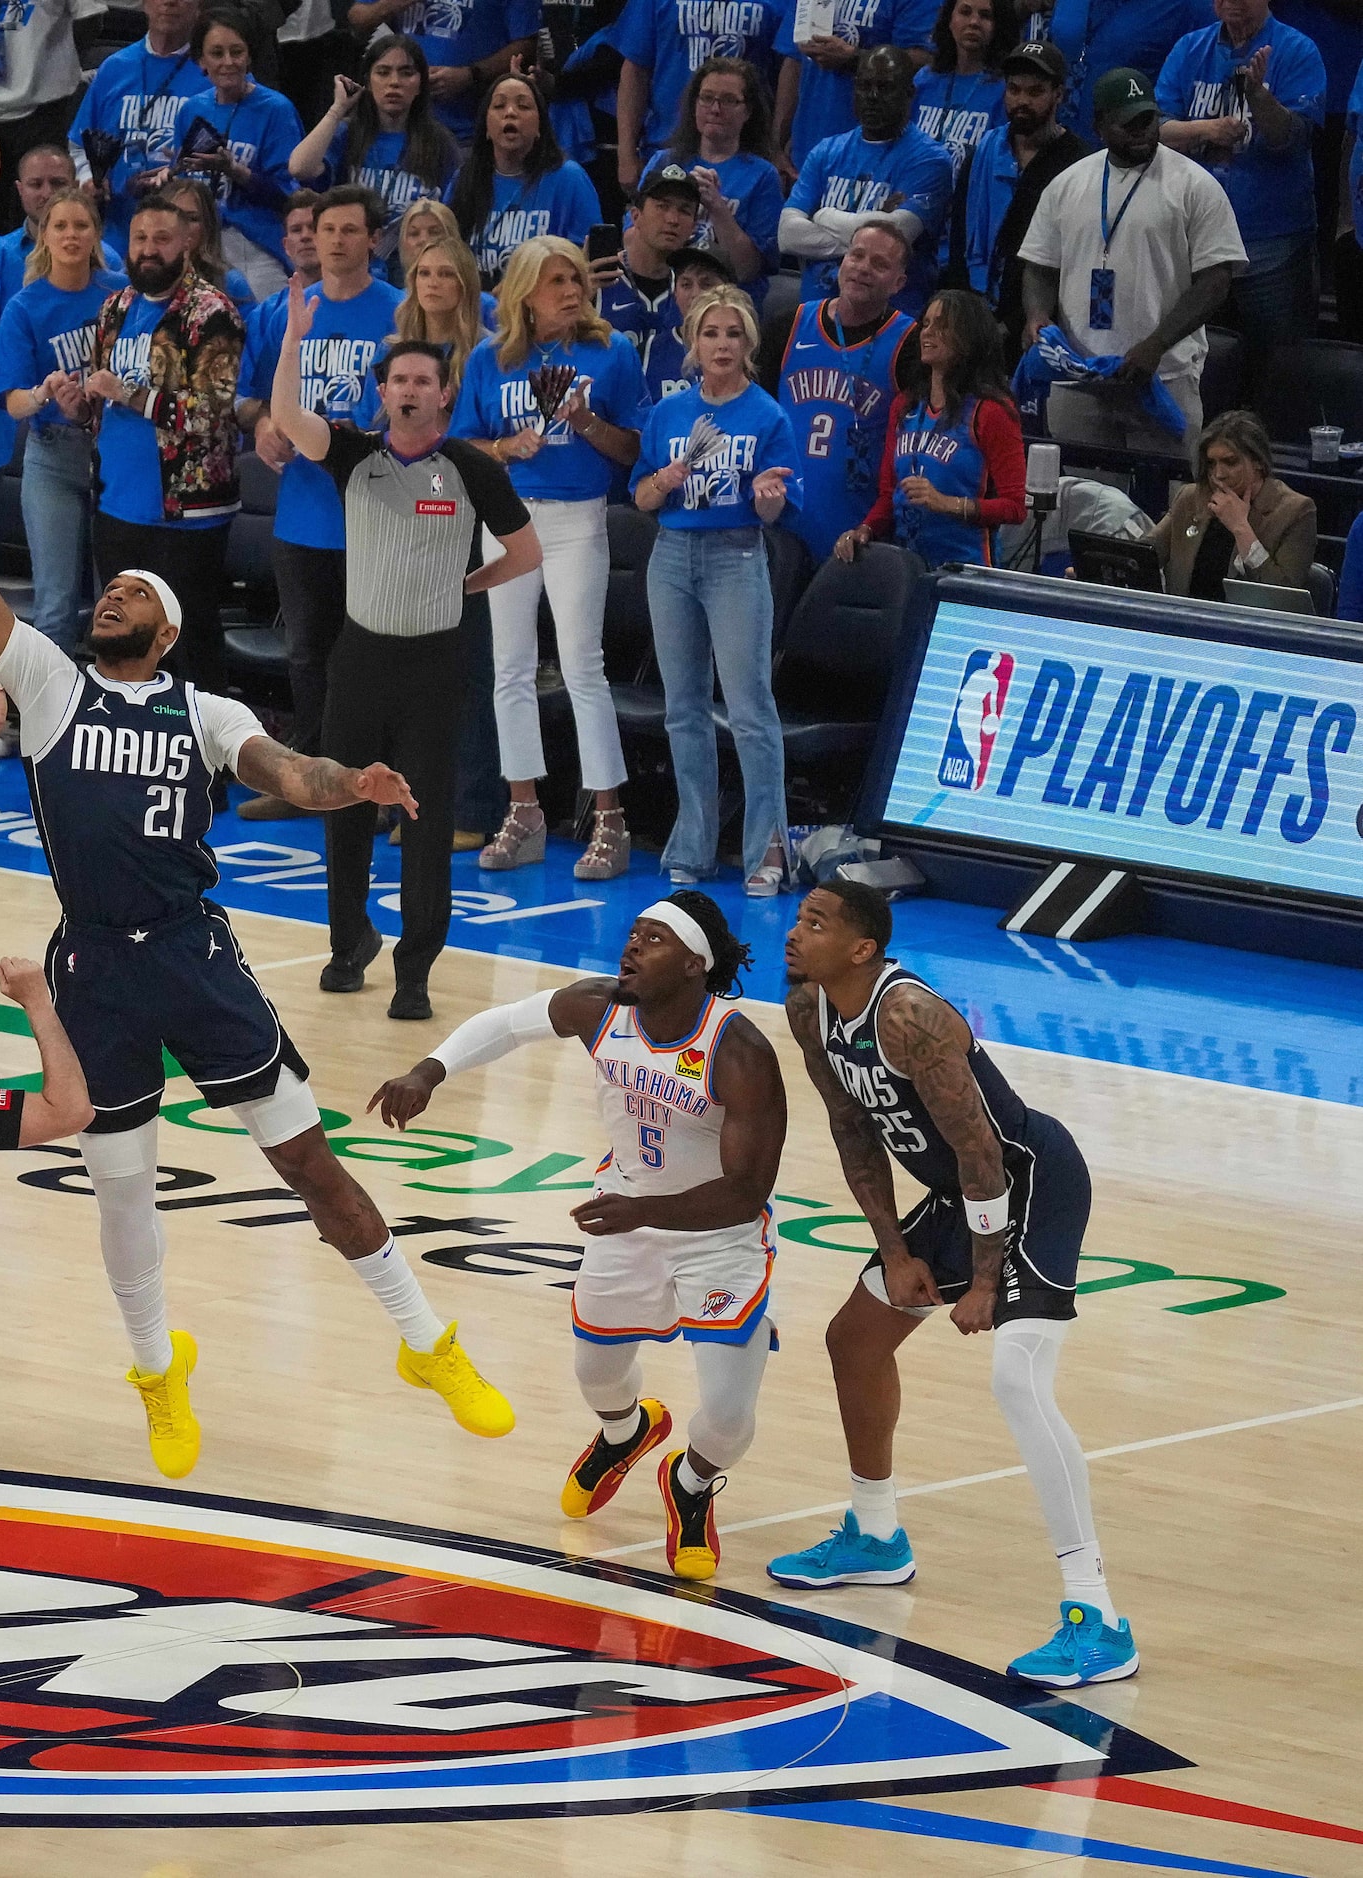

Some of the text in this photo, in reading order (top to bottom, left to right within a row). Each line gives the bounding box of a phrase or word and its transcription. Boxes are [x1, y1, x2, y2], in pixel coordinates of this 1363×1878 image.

[676, 0, 763, 36] THUNDER
[689, 37, 711, 71] UP
[1127, 78, 1144, 97] A
[808, 413, 833, 457] 2
[419, 503, 452, 512] Emirates
[153, 705, 186, 717] chime
[71, 723, 193, 781] MAVS
[996, 658, 1357, 844] PLAYOFFS
[943, 757, 970, 784] NBA
[143, 784, 187, 840] 21
[624, 1093, 673, 1127] CITY
[637, 1121, 665, 1170] 5
[871, 1110, 928, 1153] 25
